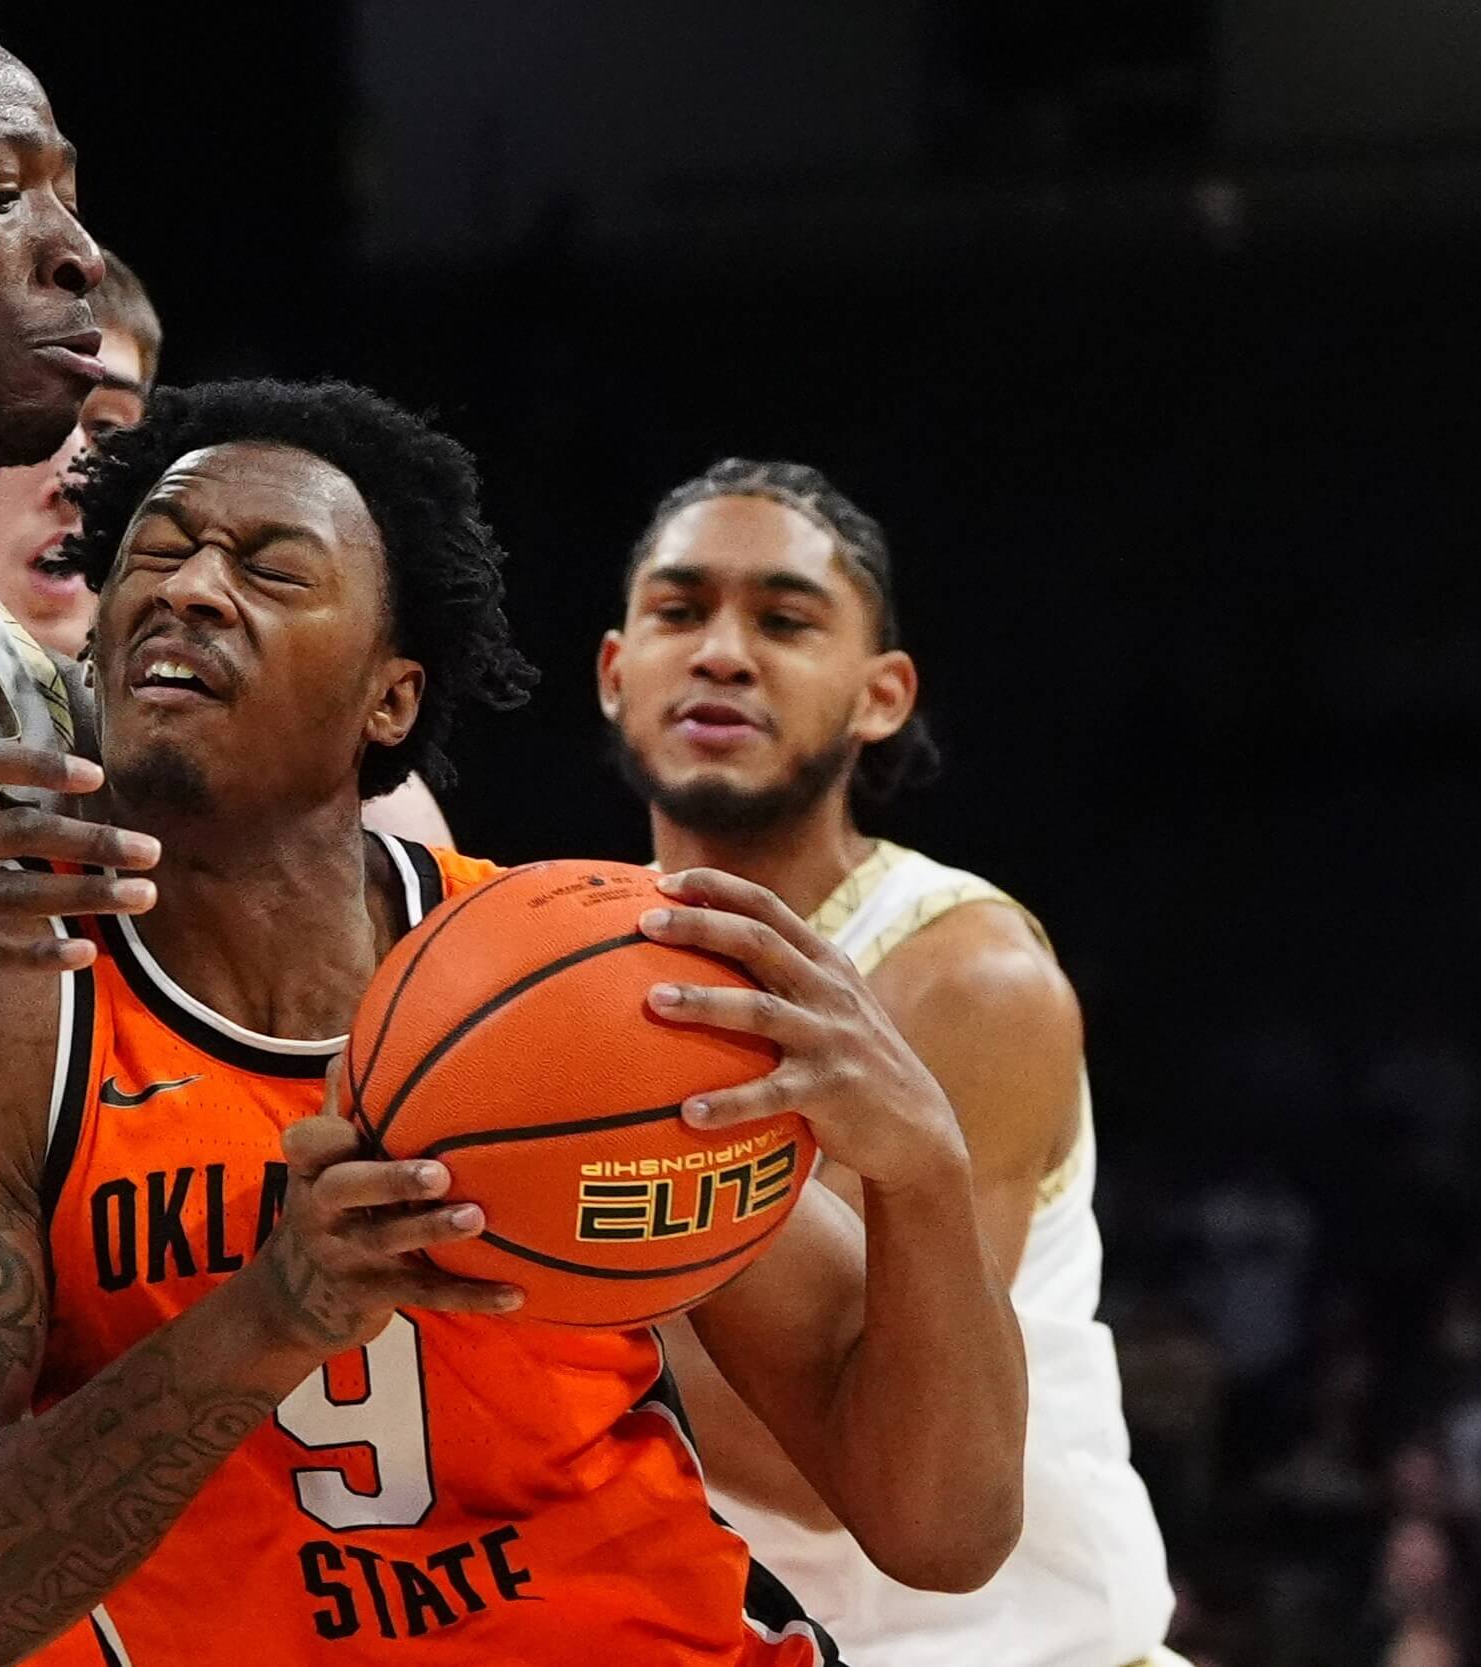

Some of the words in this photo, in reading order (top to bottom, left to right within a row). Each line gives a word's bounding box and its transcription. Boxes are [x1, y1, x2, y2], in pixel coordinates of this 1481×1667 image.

[576, 1140, 797, 1243] ELITE
[274, 1308, 437, 1533] 9
[298, 1526, 540, 1640] STATE
